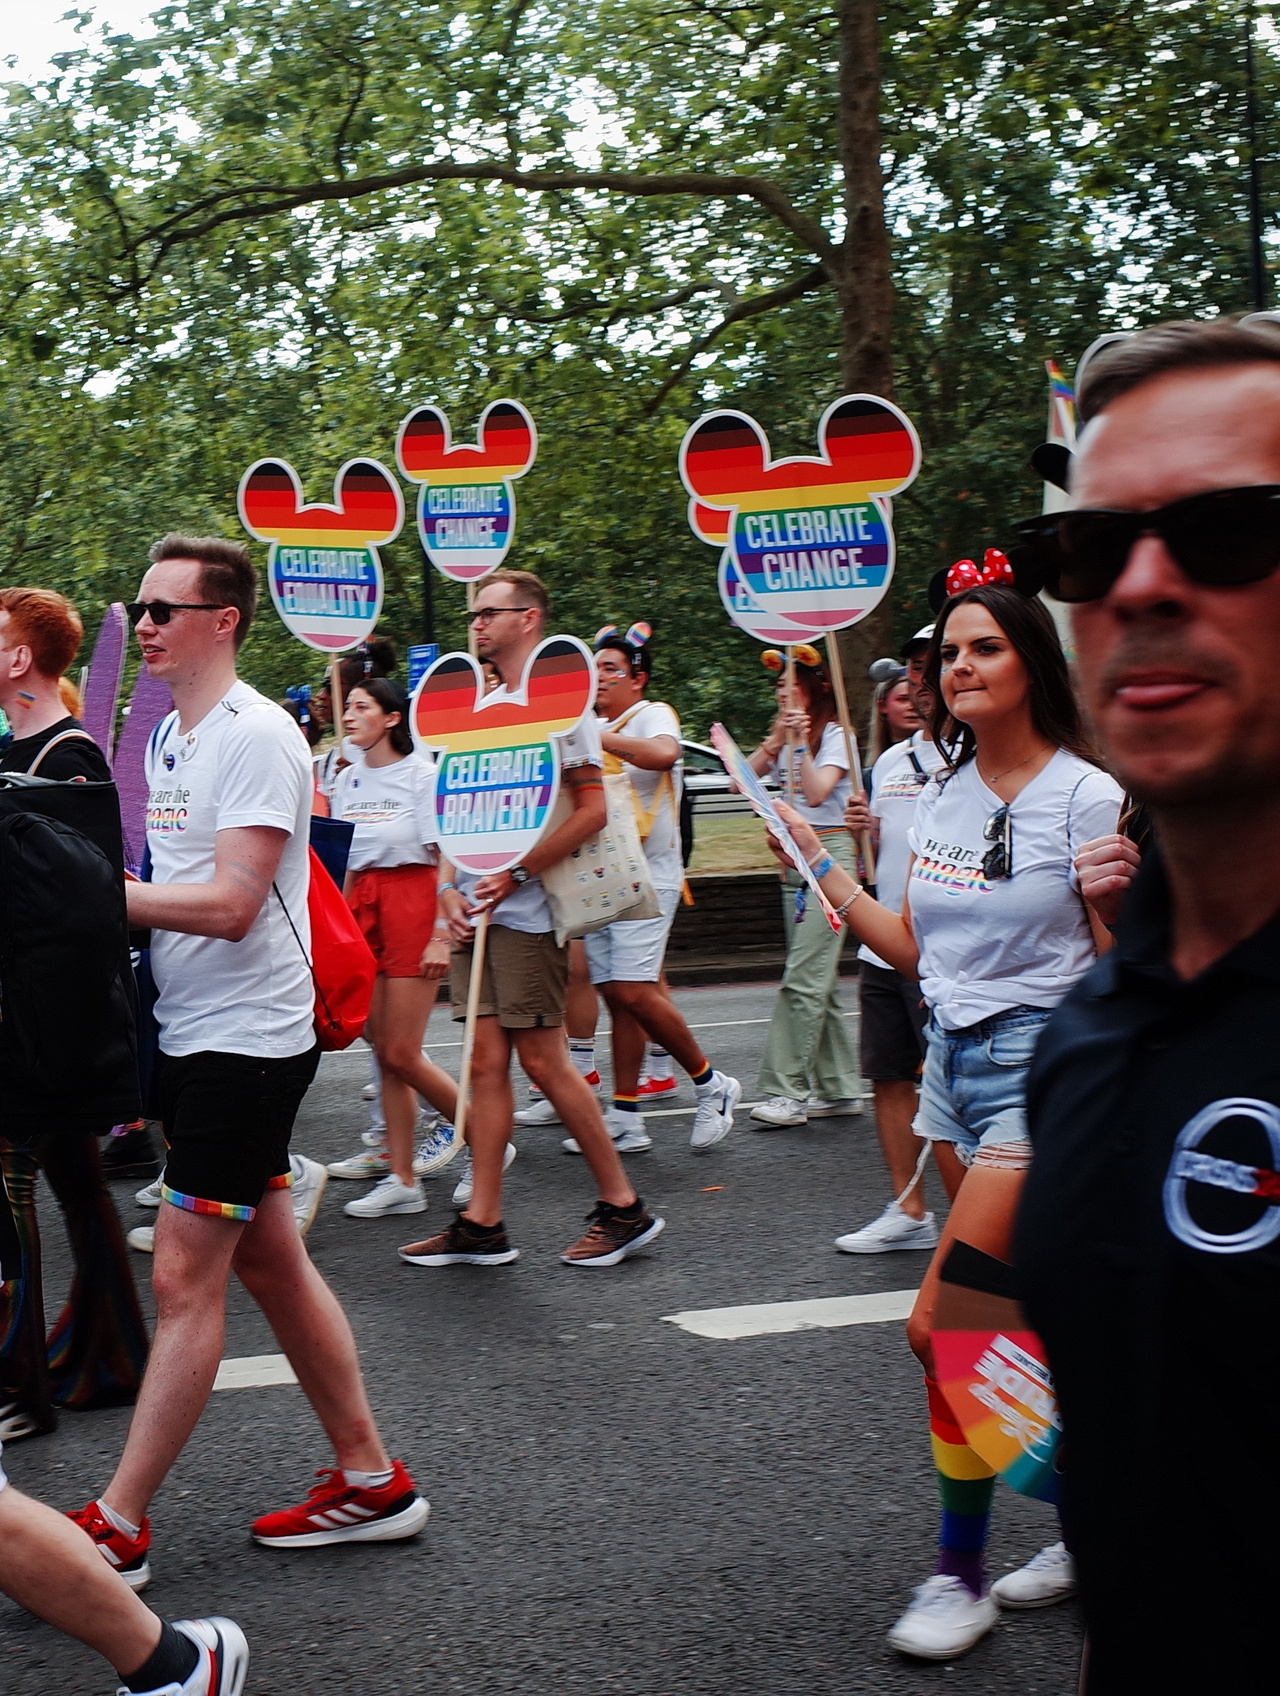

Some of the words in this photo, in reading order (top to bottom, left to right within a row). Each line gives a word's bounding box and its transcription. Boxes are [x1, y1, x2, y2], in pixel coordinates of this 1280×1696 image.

[427, 486, 504, 514] CELEBRATE
[435, 517, 498, 548] CHANGE
[743, 506, 873, 549] CELEBRATE
[280, 548, 369, 580] CELEBRATE
[761, 547, 869, 590] CHANGE
[282, 581, 370, 617] EQUALITY
[446, 746, 547, 790] CELEBRATE
[155, 790, 173, 804] are
[442, 785, 544, 835] BRAVERY
[922, 838, 948, 856] we
